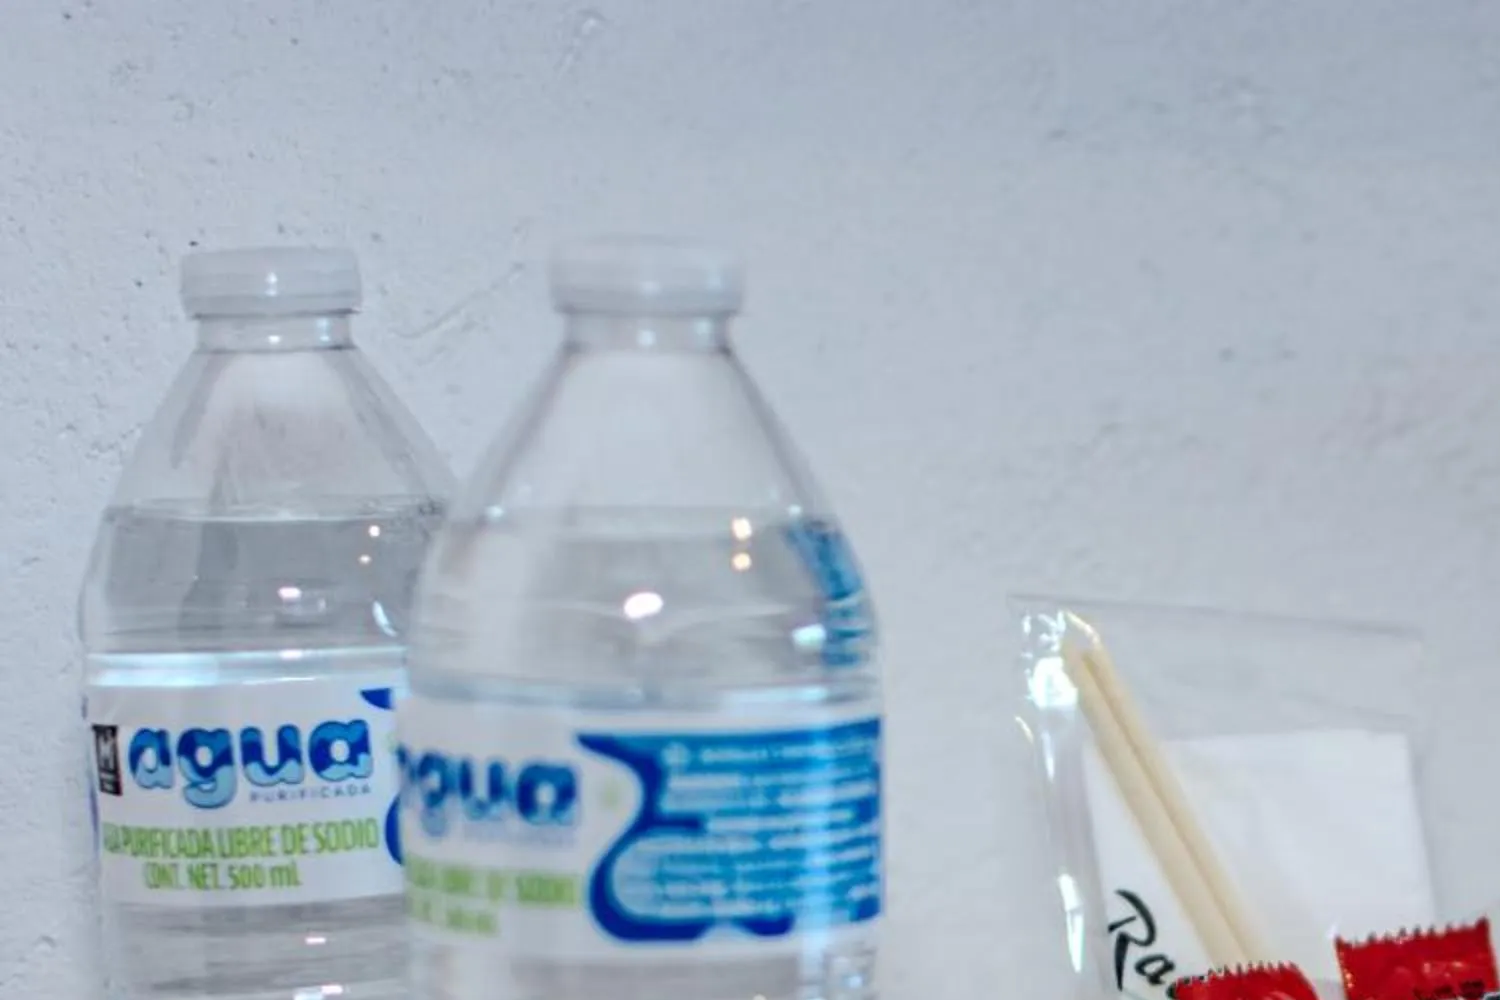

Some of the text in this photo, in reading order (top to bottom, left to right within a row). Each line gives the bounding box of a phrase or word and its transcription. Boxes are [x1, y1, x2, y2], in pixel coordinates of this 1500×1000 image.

[128, 719, 373, 809] agua
[248, 784, 371, 803] PURIFICADA
[218, 825, 277, 858] LIBRE
[281, 824, 310, 854] DE
[312, 818, 379, 853] SODIO
